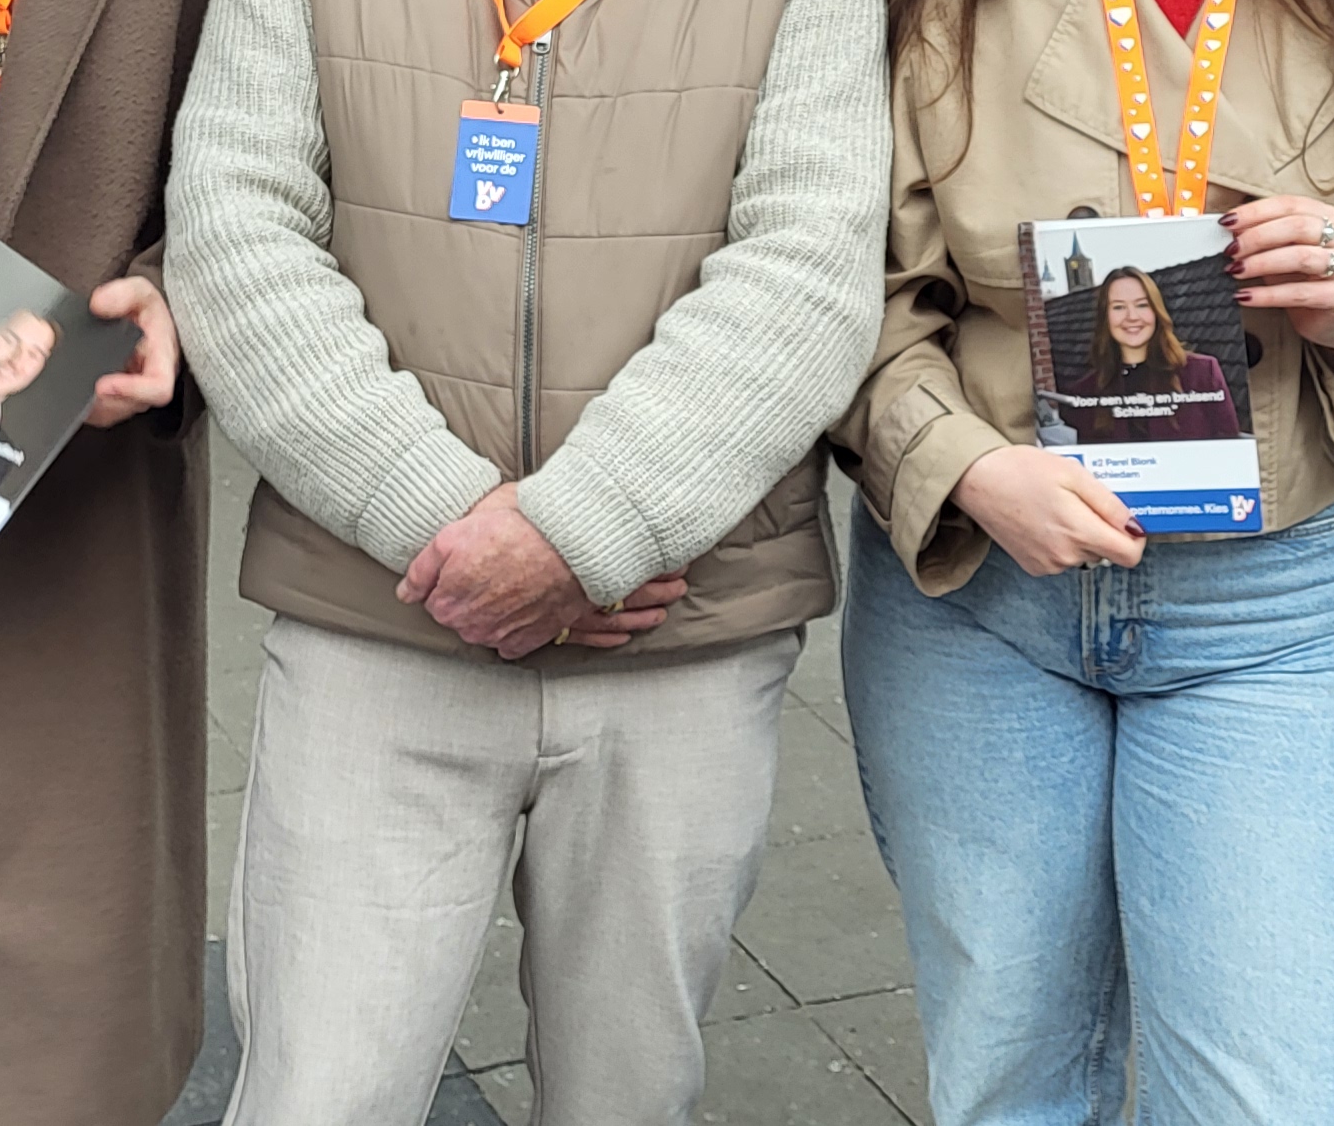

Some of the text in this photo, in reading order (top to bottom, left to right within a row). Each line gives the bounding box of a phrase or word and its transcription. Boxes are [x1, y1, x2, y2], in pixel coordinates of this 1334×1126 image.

[492, 135, 516, 149] ben
[465, 148, 526, 163] vrijwilliger
[471, 162, 517, 176] voor de
